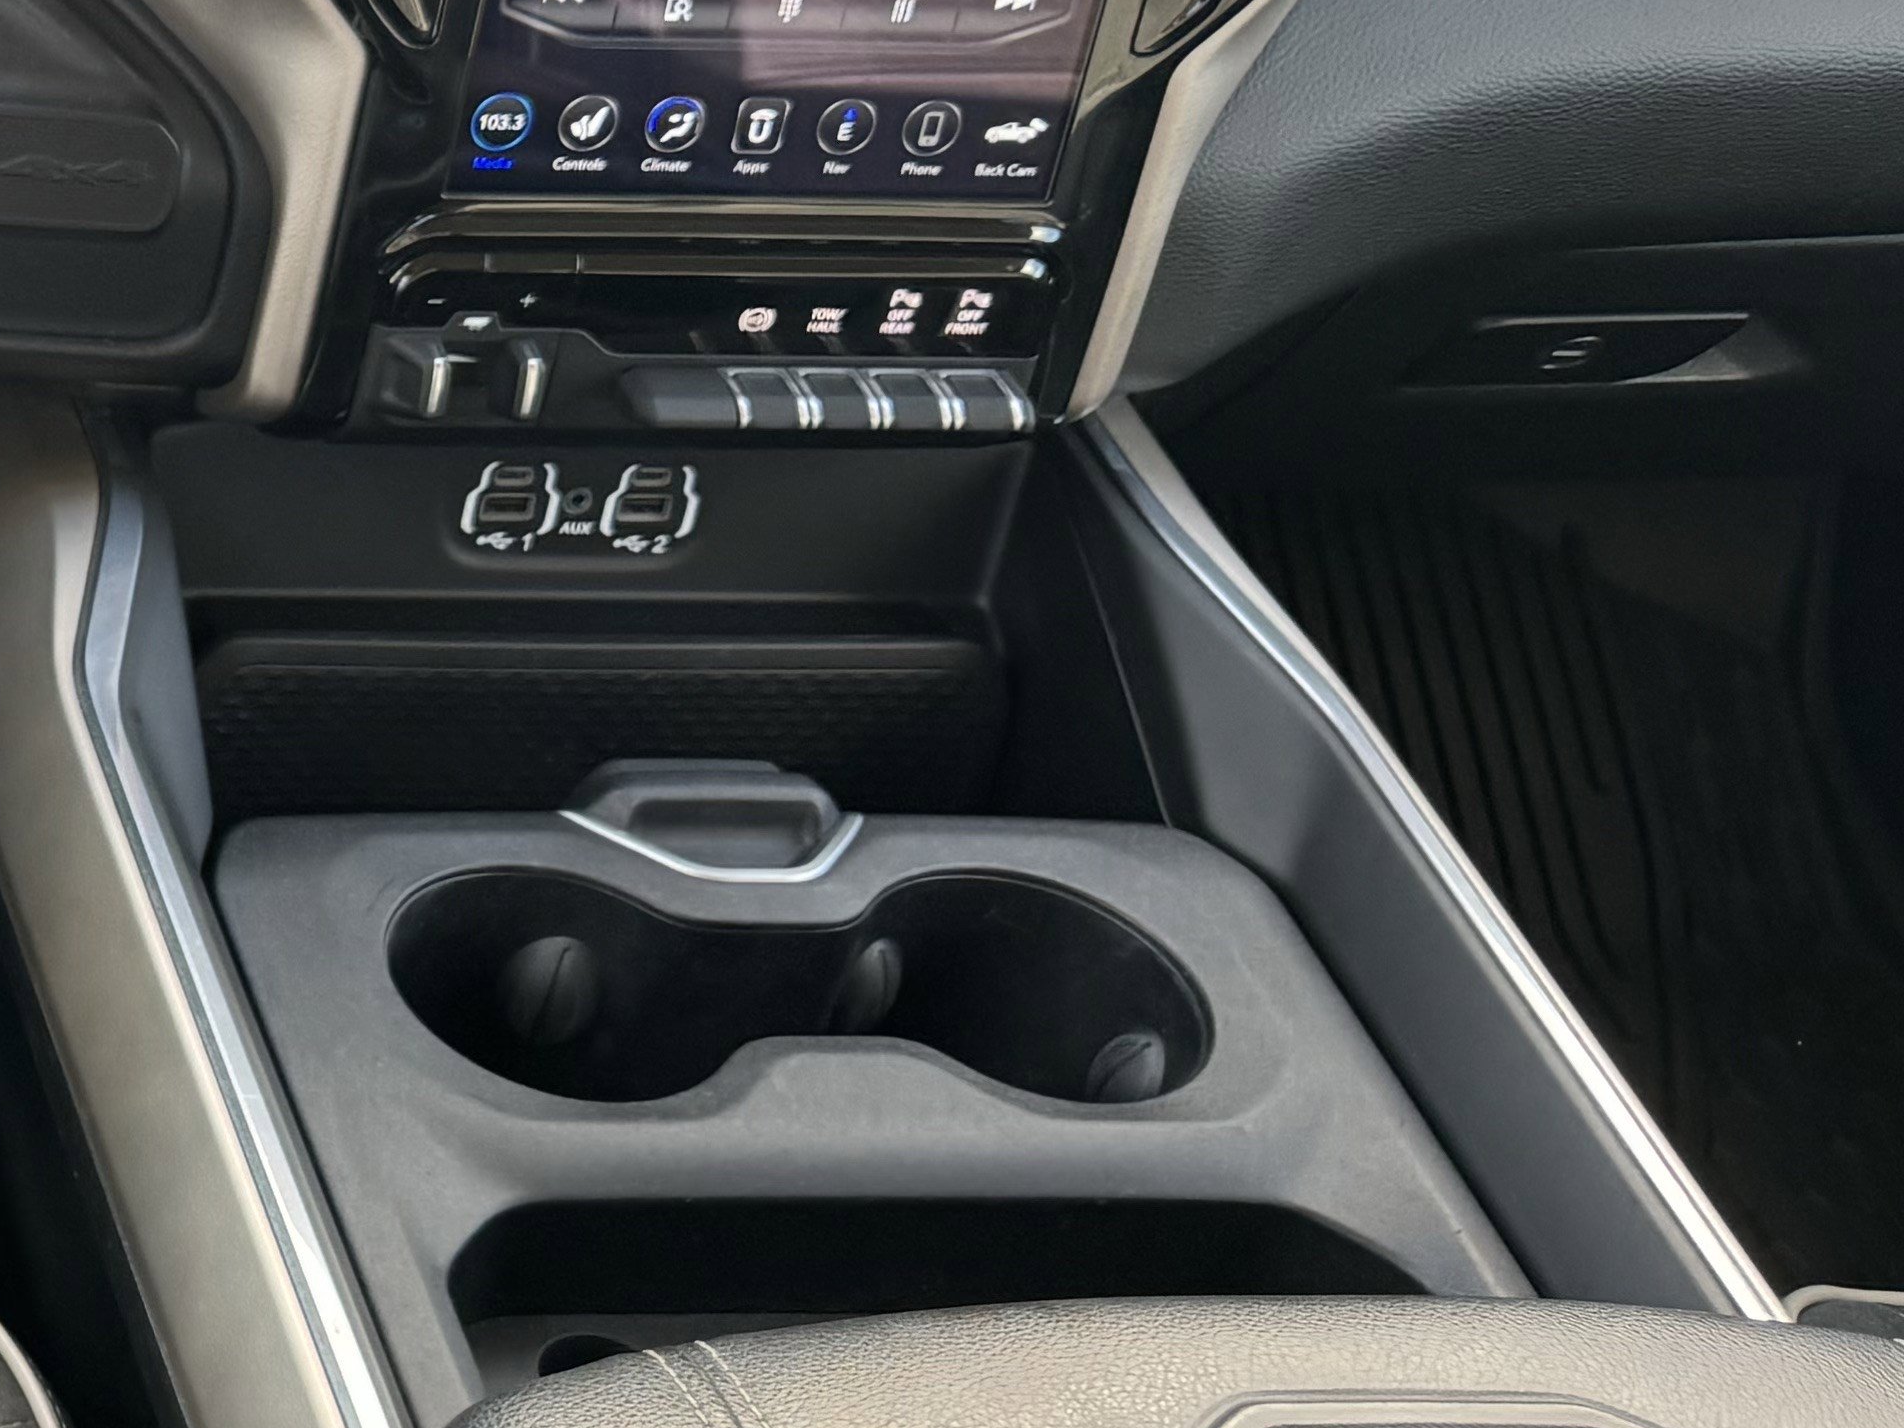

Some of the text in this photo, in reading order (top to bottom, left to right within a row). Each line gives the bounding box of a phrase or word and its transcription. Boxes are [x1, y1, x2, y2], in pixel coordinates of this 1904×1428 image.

[479, 112, 526, 132] 103.3
[551, 156, 608, 173] Controls
[640, 157, 693, 173] Climate
[732, 159, 771, 175] Apps
[900, 161, 943, 177] Phone
[974, 163, 1007, 178] Back
[944, 321, 990, 335] FRONT
[558, 521, 594, 536] AUX
[651, 534, 672, 554] 2
